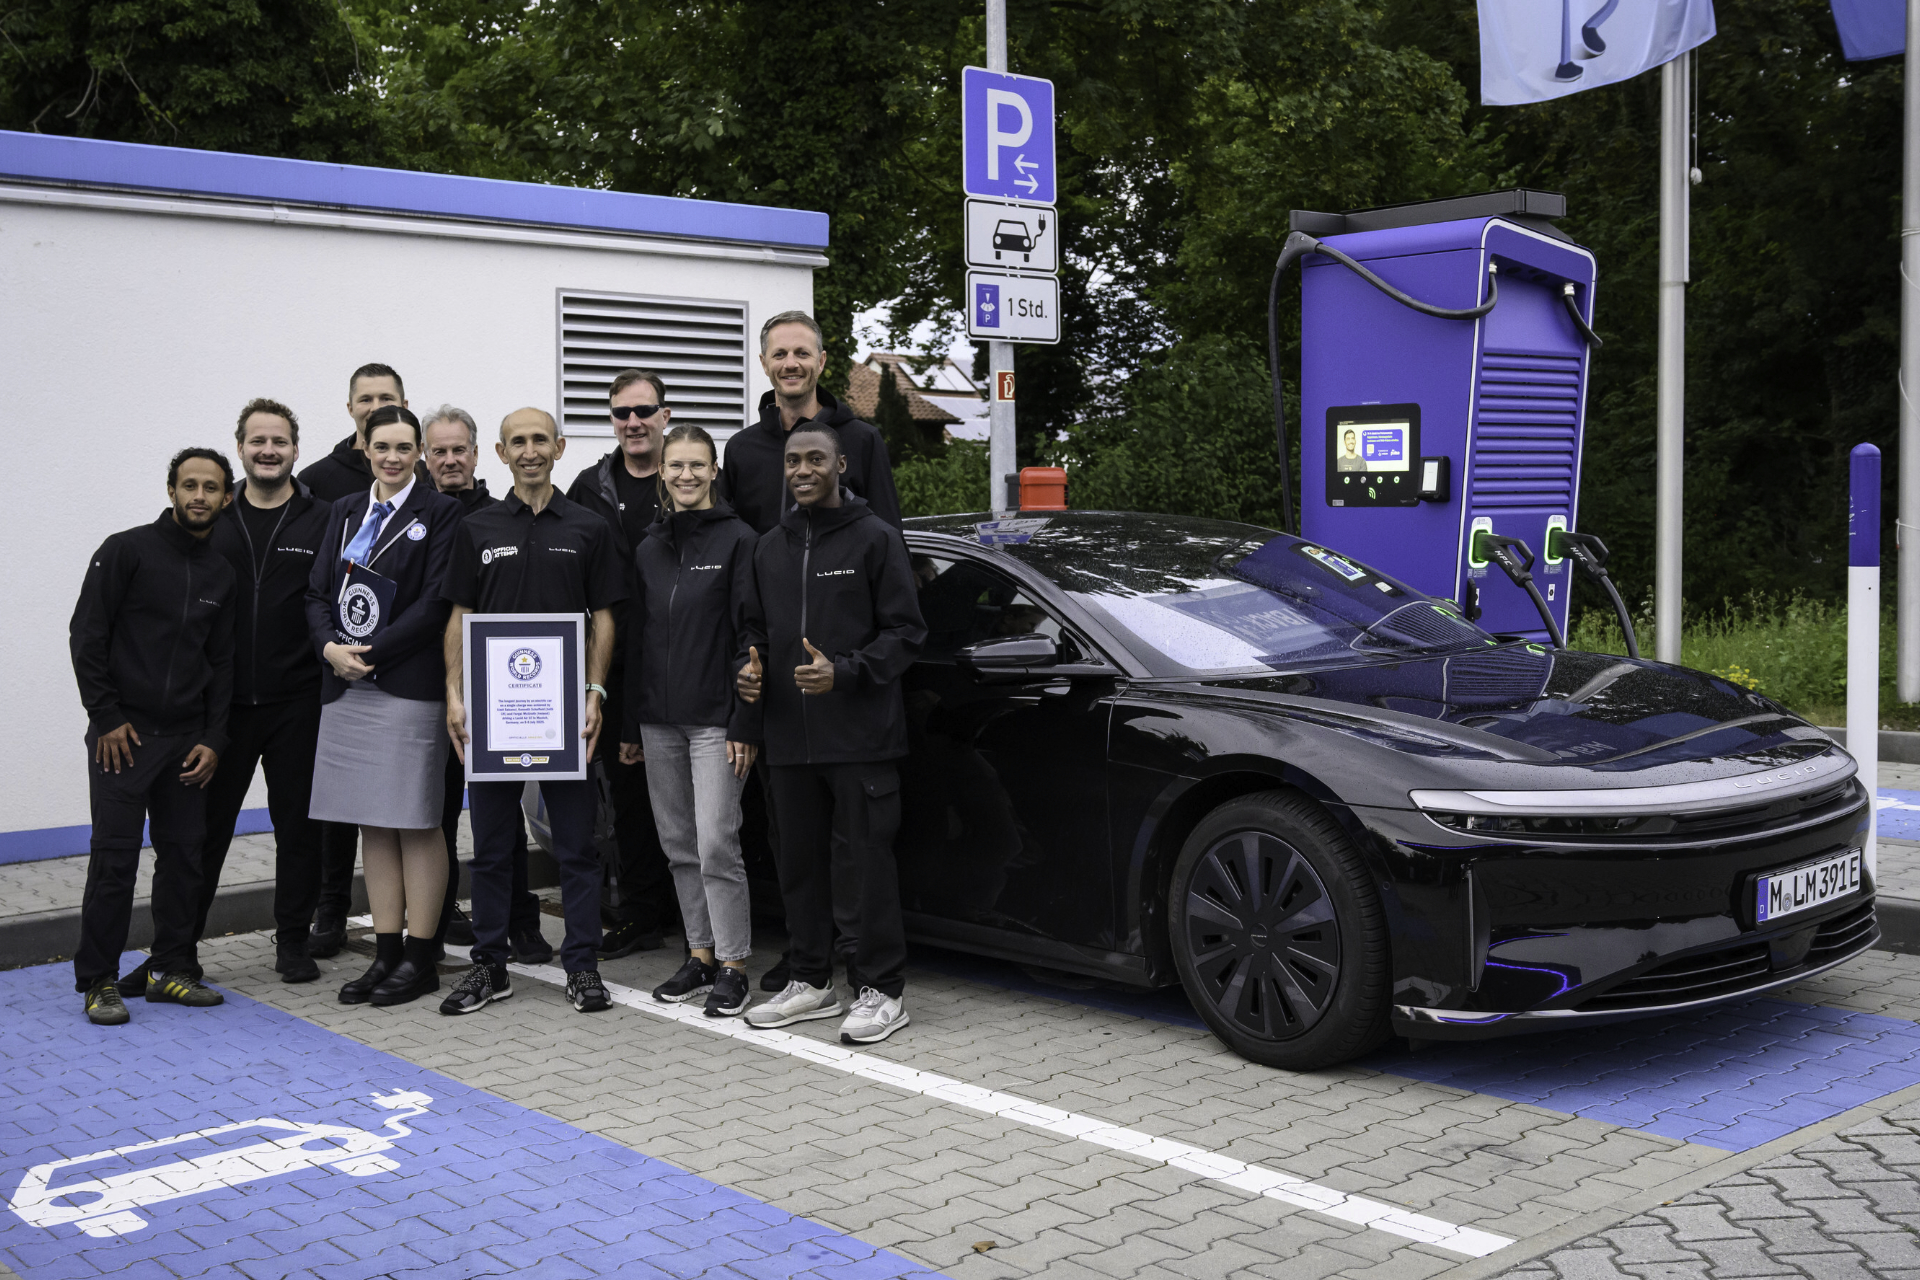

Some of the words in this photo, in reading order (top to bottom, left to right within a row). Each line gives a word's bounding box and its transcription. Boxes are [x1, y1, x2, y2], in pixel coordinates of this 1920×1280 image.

[987, 88, 1033, 180] P
[1008, 298, 1013, 317] 1
[1018, 298, 1048, 319] Std.
[985, 314, 991, 323] P
[278, 547, 314, 555] LUCID
[493, 546, 518, 554] OFFICIAL
[1494, 550, 1513, 566] HPC
[1570, 546, 1588, 562] HPC
[817, 569, 855, 577] LUCID
[348, 587, 376, 607] GUINNESS
[342, 601, 351, 627] WORLD
[351, 613, 377, 634] RECORDS
[512, 649, 538, 659] GUINNESS
[509, 662, 522, 679] WORLD
[522, 661, 541, 680] RECORDS
[1734, 765, 1817, 789] LUCID
[1770, 879, 1782, 914] M
[1760, 904, 1765, 914] D
